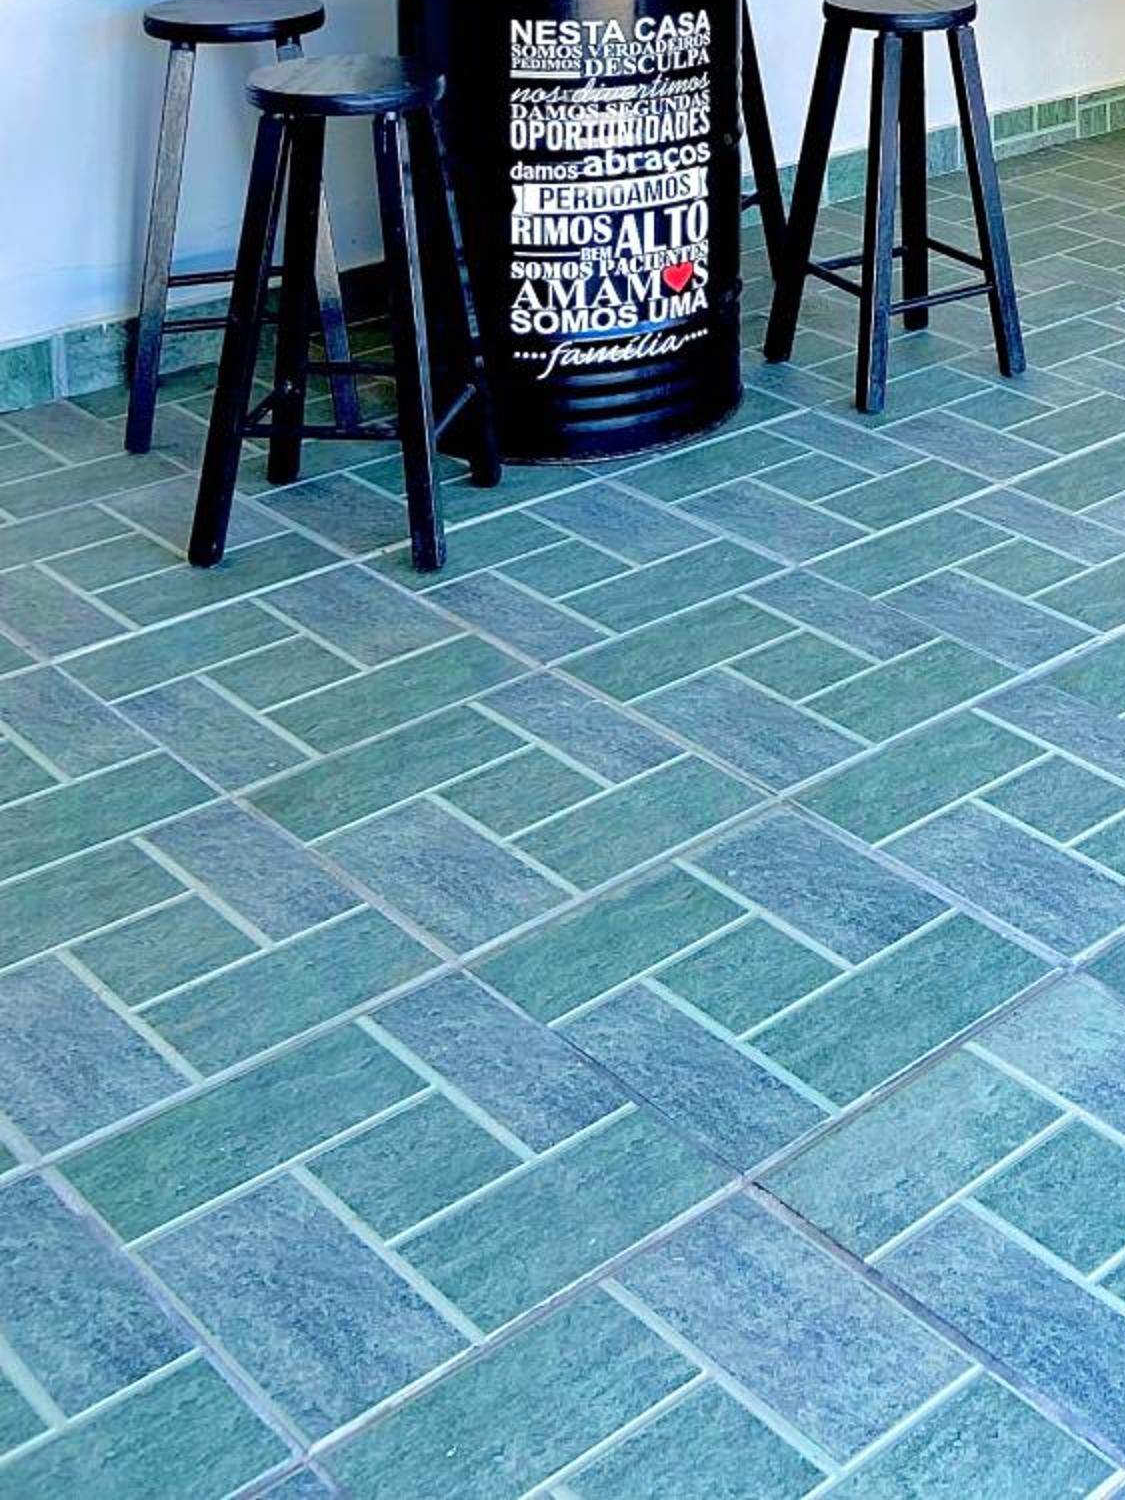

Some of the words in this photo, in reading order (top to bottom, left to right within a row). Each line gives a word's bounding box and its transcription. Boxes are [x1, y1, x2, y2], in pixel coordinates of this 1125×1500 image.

[510, 19, 626, 45] NESTA
[634, 9, 711, 41] CASA
[510, 44, 583, 59] SOMOS
[587, 32, 711, 58] VERDADEIROS
[510, 57, 581, 70] PEDIMOS
[583, 48, 711, 77] DESCULPA
[510, 86, 562, 102] nos
[571, 71, 711, 102] divertimos
[510, 103, 600, 120] DAMOS
[605, 89, 711, 117] SEGUNDAS
[510, 105, 711, 151] OPORTUNIDADES
[510, 160, 579, 181] damos
[583, 142, 711, 176] abraços
[539, 173, 691, 210] PERDOAMOS
[511, 214, 613, 245] RIMOS
[581, 246, 612, 260] BEM
[614, 199, 709, 258] ALTO
[510, 261, 593, 280] SOMOS
[599, 240, 709, 277] PACIENTES
[510, 259, 709, 311] AMAMS
[510, 306, 638, 334] SOMOS
[649, 288, 709, 323] UMA
